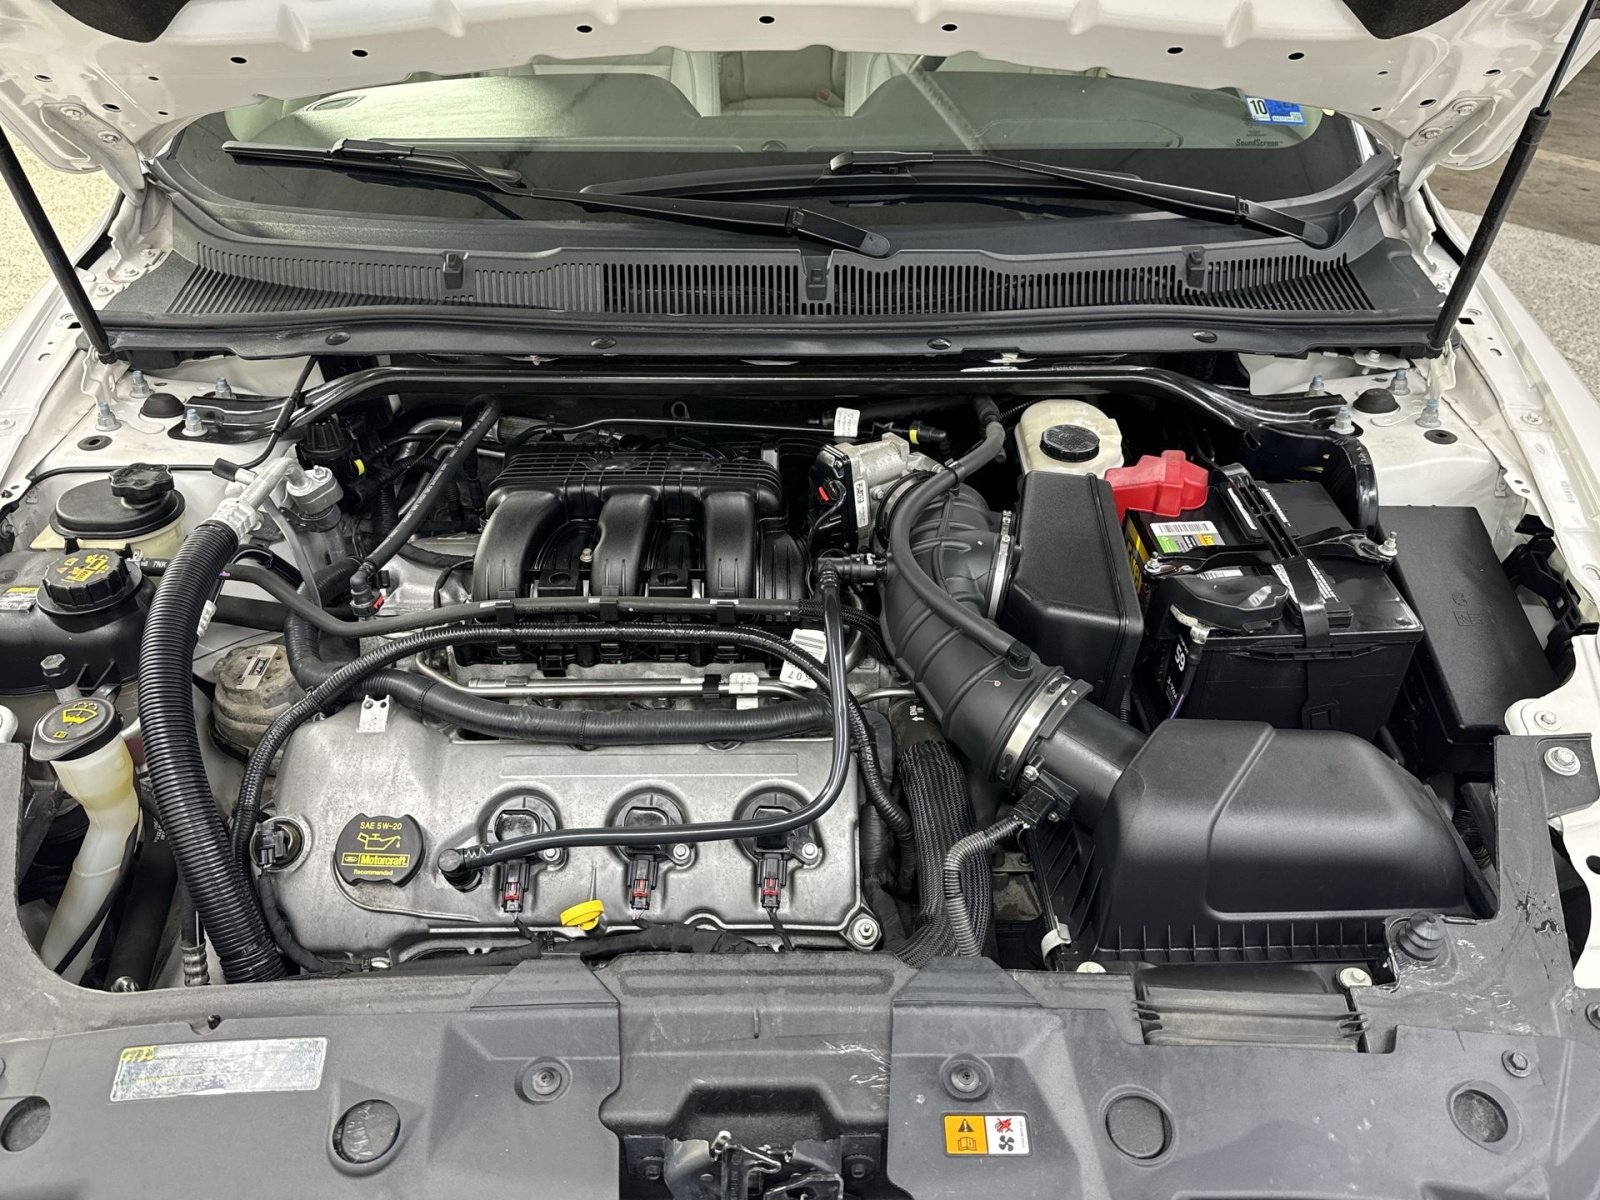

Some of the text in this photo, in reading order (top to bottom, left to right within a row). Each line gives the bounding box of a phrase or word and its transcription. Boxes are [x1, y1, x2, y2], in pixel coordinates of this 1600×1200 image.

[1249, 99, 1268, 115] 10
[1174, 643, 1186, 672] 59
[360, 821, 403, 831] SAE 5W-20
[360, 855, 407, 866] Motorcraft
[353, 868, 394, 876] Recommended
